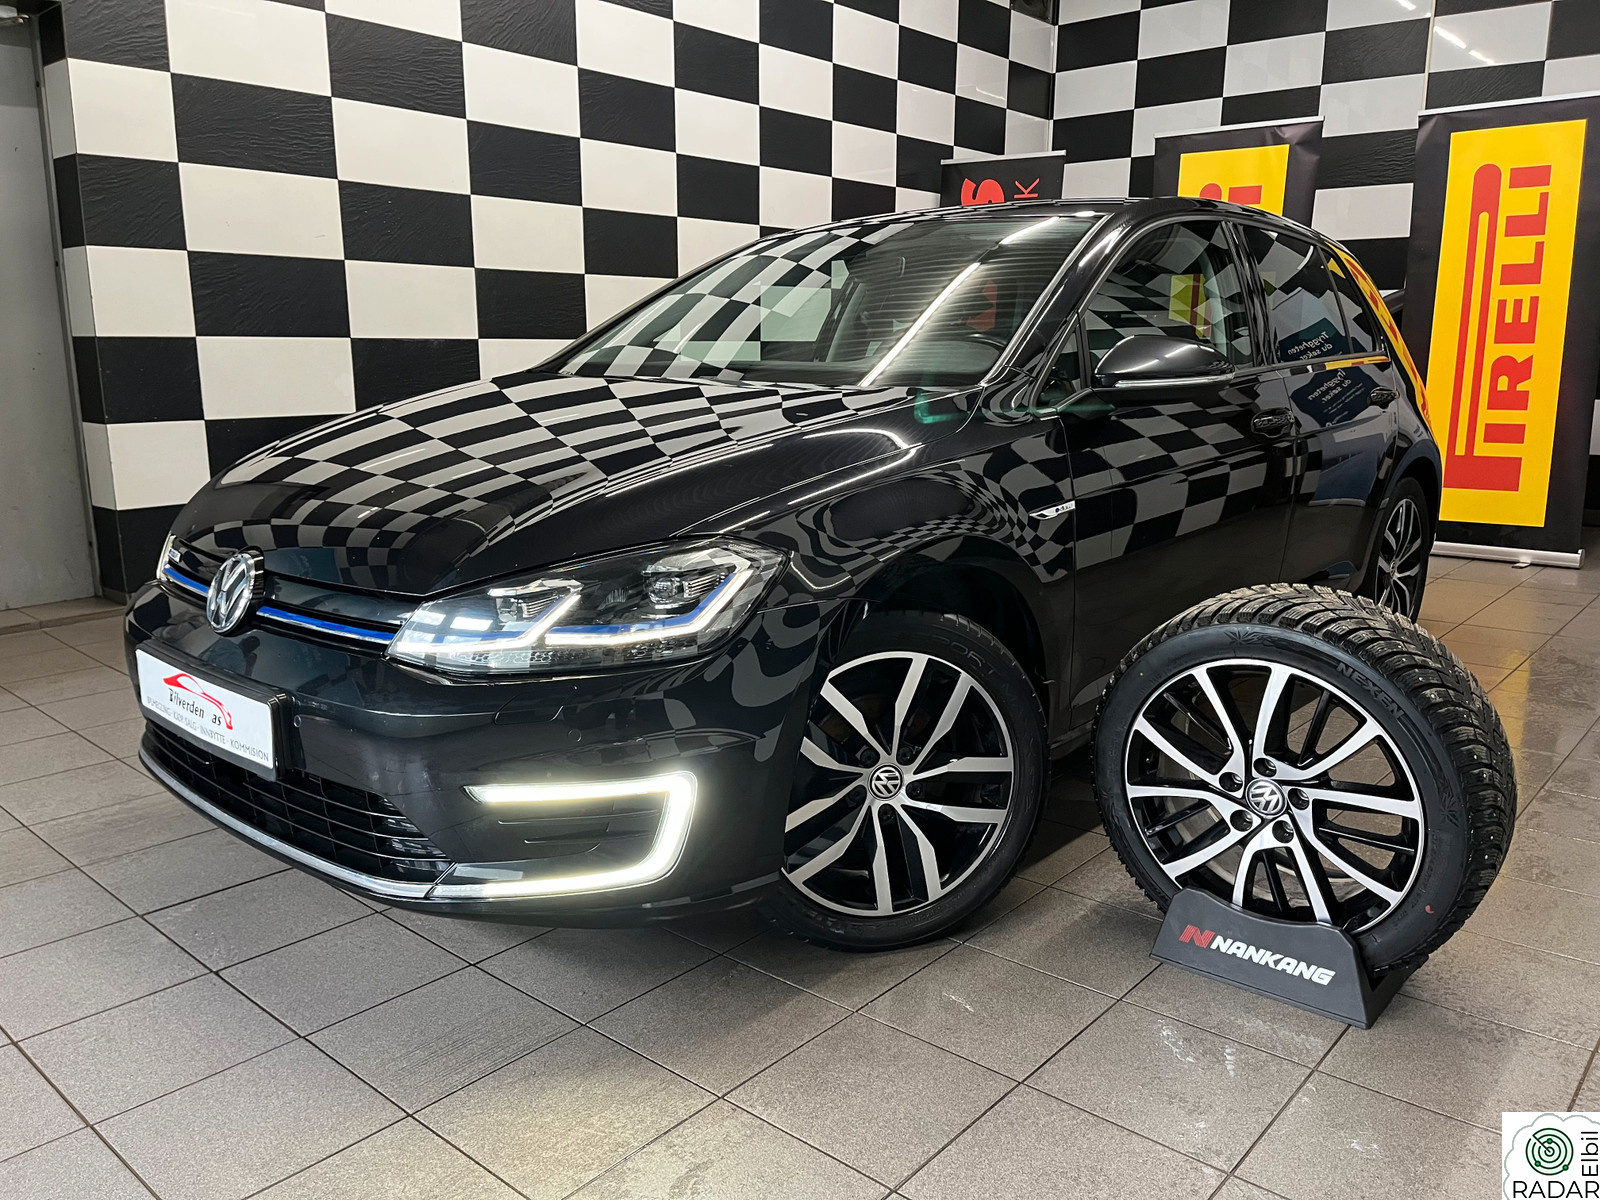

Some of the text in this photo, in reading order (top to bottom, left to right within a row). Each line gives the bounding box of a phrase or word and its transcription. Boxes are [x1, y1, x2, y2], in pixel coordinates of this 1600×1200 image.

[1443, 163, 1552, 492] PIRELLI
[1336, 662, 1405, 718] NEXEN
[211, 714, 222, 726] as
[1210, 935, 1336, 986] NANKANG
